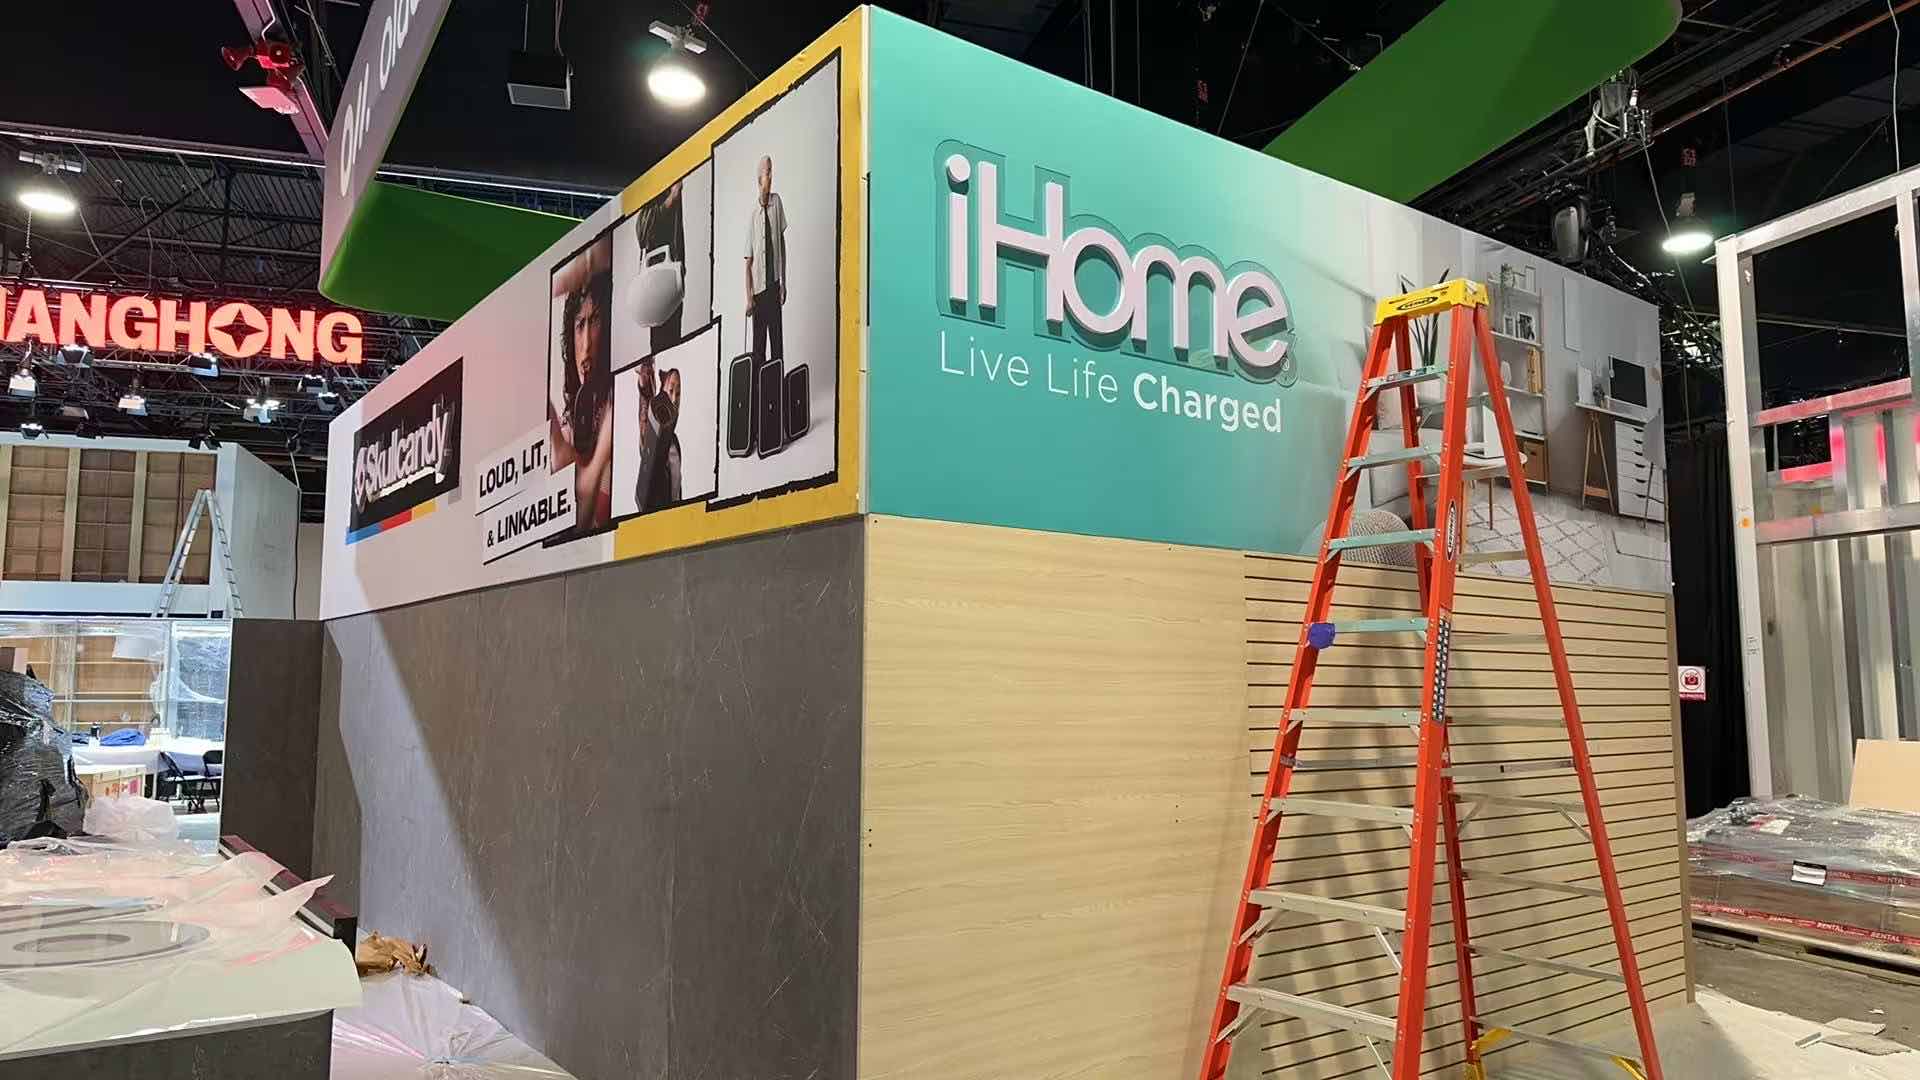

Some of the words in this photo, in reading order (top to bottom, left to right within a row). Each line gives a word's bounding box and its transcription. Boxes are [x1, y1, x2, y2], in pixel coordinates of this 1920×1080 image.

[945, 154, 1289, 371] iHome
[939, 331, 1030, 387] Live
[1048, 353, 1119, 403] Life
[1133, 373, 1282, 433] Charged
[479, 457, 518, 498] LOUD,
[523, 439, 547, 474] LIT,
[487, 530, 494, 547] &
[497, 488, 571, 543] LINKABLE.
